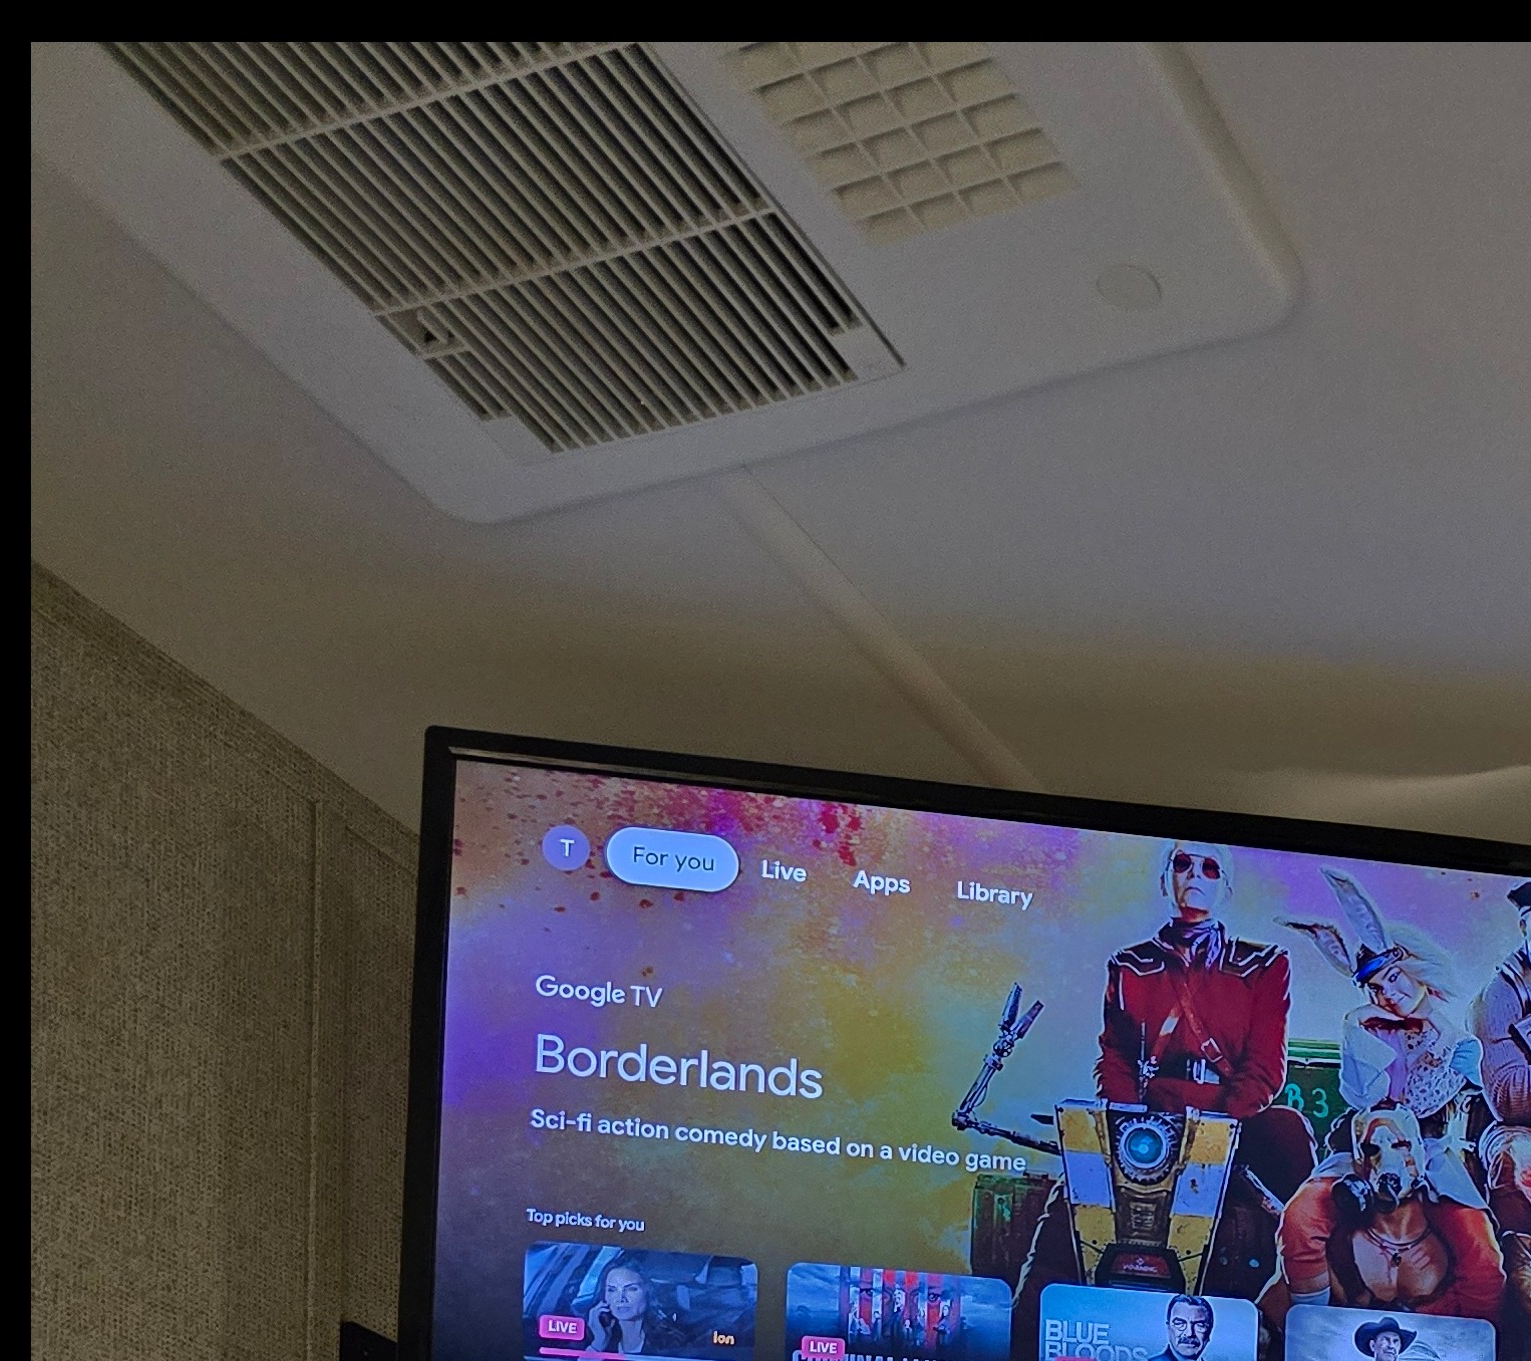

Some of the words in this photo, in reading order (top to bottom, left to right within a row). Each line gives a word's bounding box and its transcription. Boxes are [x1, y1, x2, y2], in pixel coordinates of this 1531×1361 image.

[559, 838, 575, 858] T
[632, 844, 670, 869] For
[674, 851, 716, 873] you
[760, 859, 808, 884] Live
[853, 869, 912, 897] Apps
[956, 880, 1034, 911] Library
[535, 973, 626, 1008] Google
[630, 984, 663, 1009] TV
[535, 1032, 824, 1100] Borderlands
[530, 1107, 593, 1134] Sci-fi
[597, 1115, 670, 1140] action
[674, 1121, 768, 1154] comedy
[771, 1130, 842, 1157] based
[845, 1140, 876, 1159] on
[879, 1142, 894, 1160] a
[897, 1142, 961, 1168] video
[964, 1149, 1028, 1176] game
[526, 1207, 554, 1226] Top
[554, 1211, 593, 1229] picks
[594, 1213, 616, 1230] for
[618, 1217, 645, 1233] you
[547, 1319, 578, 1335] LIVE
[1044, 1318, 1110, 1345] BLUE
[809, 1340, 839, 1355] LIVE
